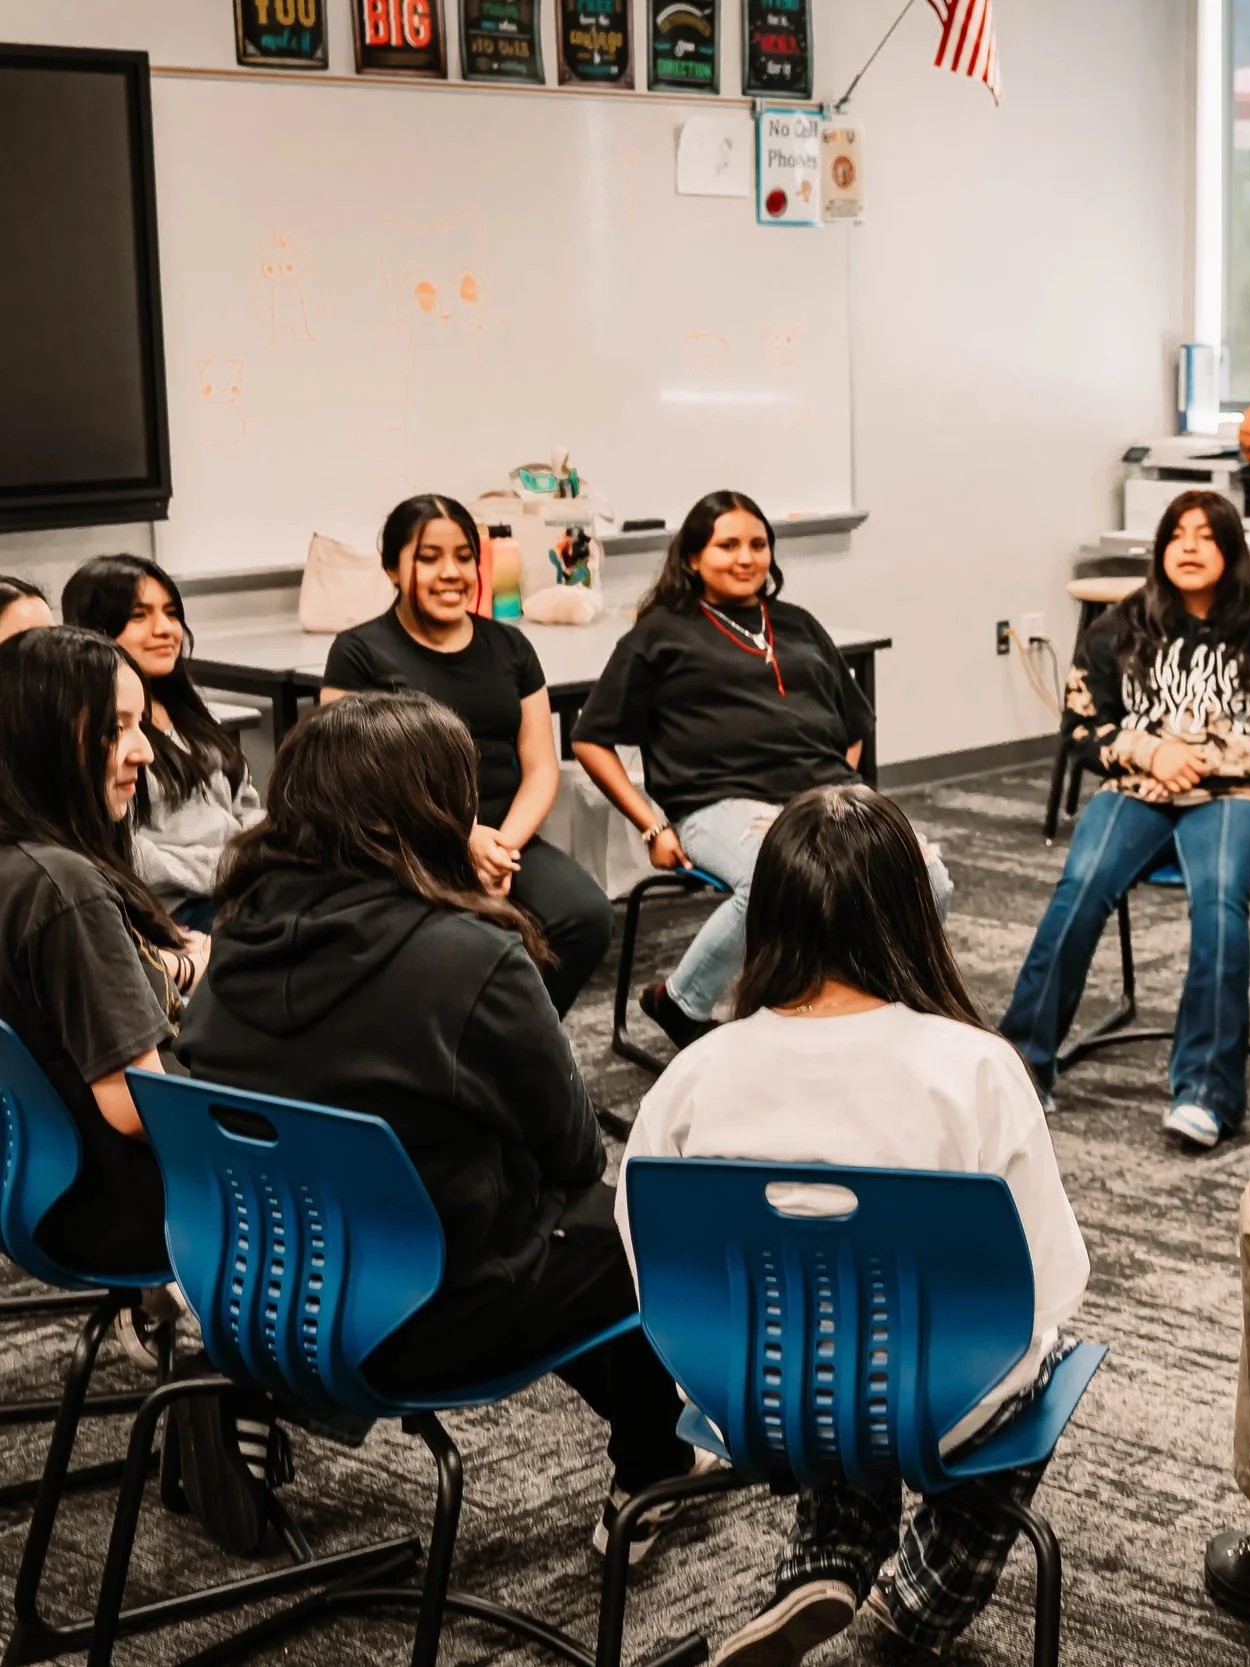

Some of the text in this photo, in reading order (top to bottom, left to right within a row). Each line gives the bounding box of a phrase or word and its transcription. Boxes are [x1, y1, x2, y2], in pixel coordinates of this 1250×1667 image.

[255, 0, 315, 28] YOU
[363, 0, 432, 48] BIG
[657, 58, 712, 79] DIRECTION
[768, 120, 790, 137] No
[794, 120, 818, 138] Cell
[768, 149, 818, 168] Phones
